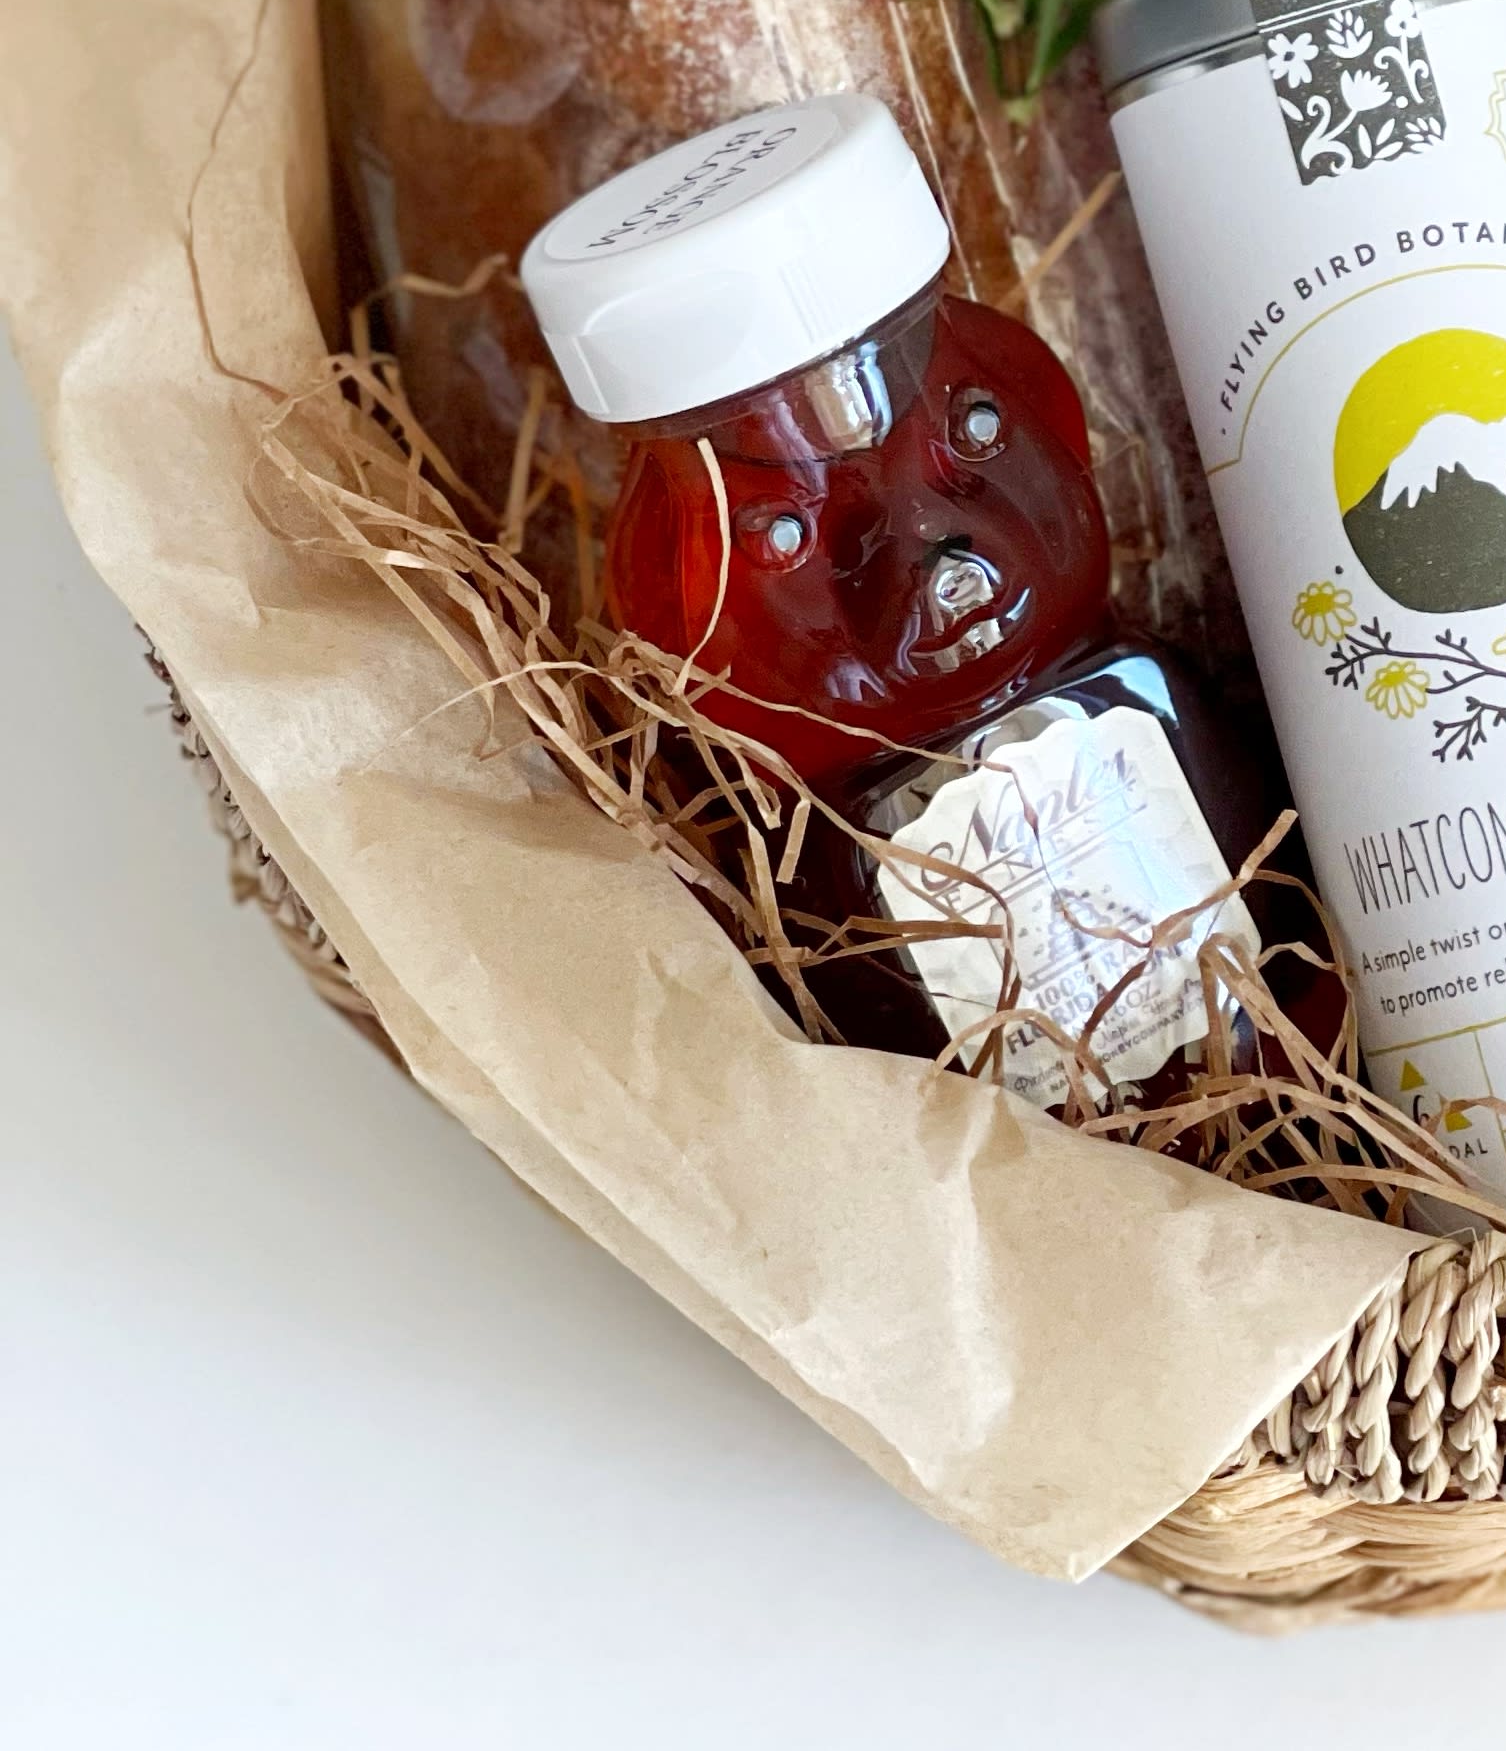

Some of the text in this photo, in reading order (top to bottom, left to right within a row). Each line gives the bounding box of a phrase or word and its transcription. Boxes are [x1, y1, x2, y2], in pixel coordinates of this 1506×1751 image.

[586, 129, 763, 248] BLOSSOM
[641, 126, 798, 235] ORANGE
[1220, 300, 1286, 412] FLYING
[1293, 242, 1377, 301] BIRD
[1361, 951, 1374, 976] A
[1375, 939, 1426, 974] simple
[1430, 925, 1481, 957] twist
[1380, 993, 1397, 1016] to
[1398, 972, 1480, 1017] promote
